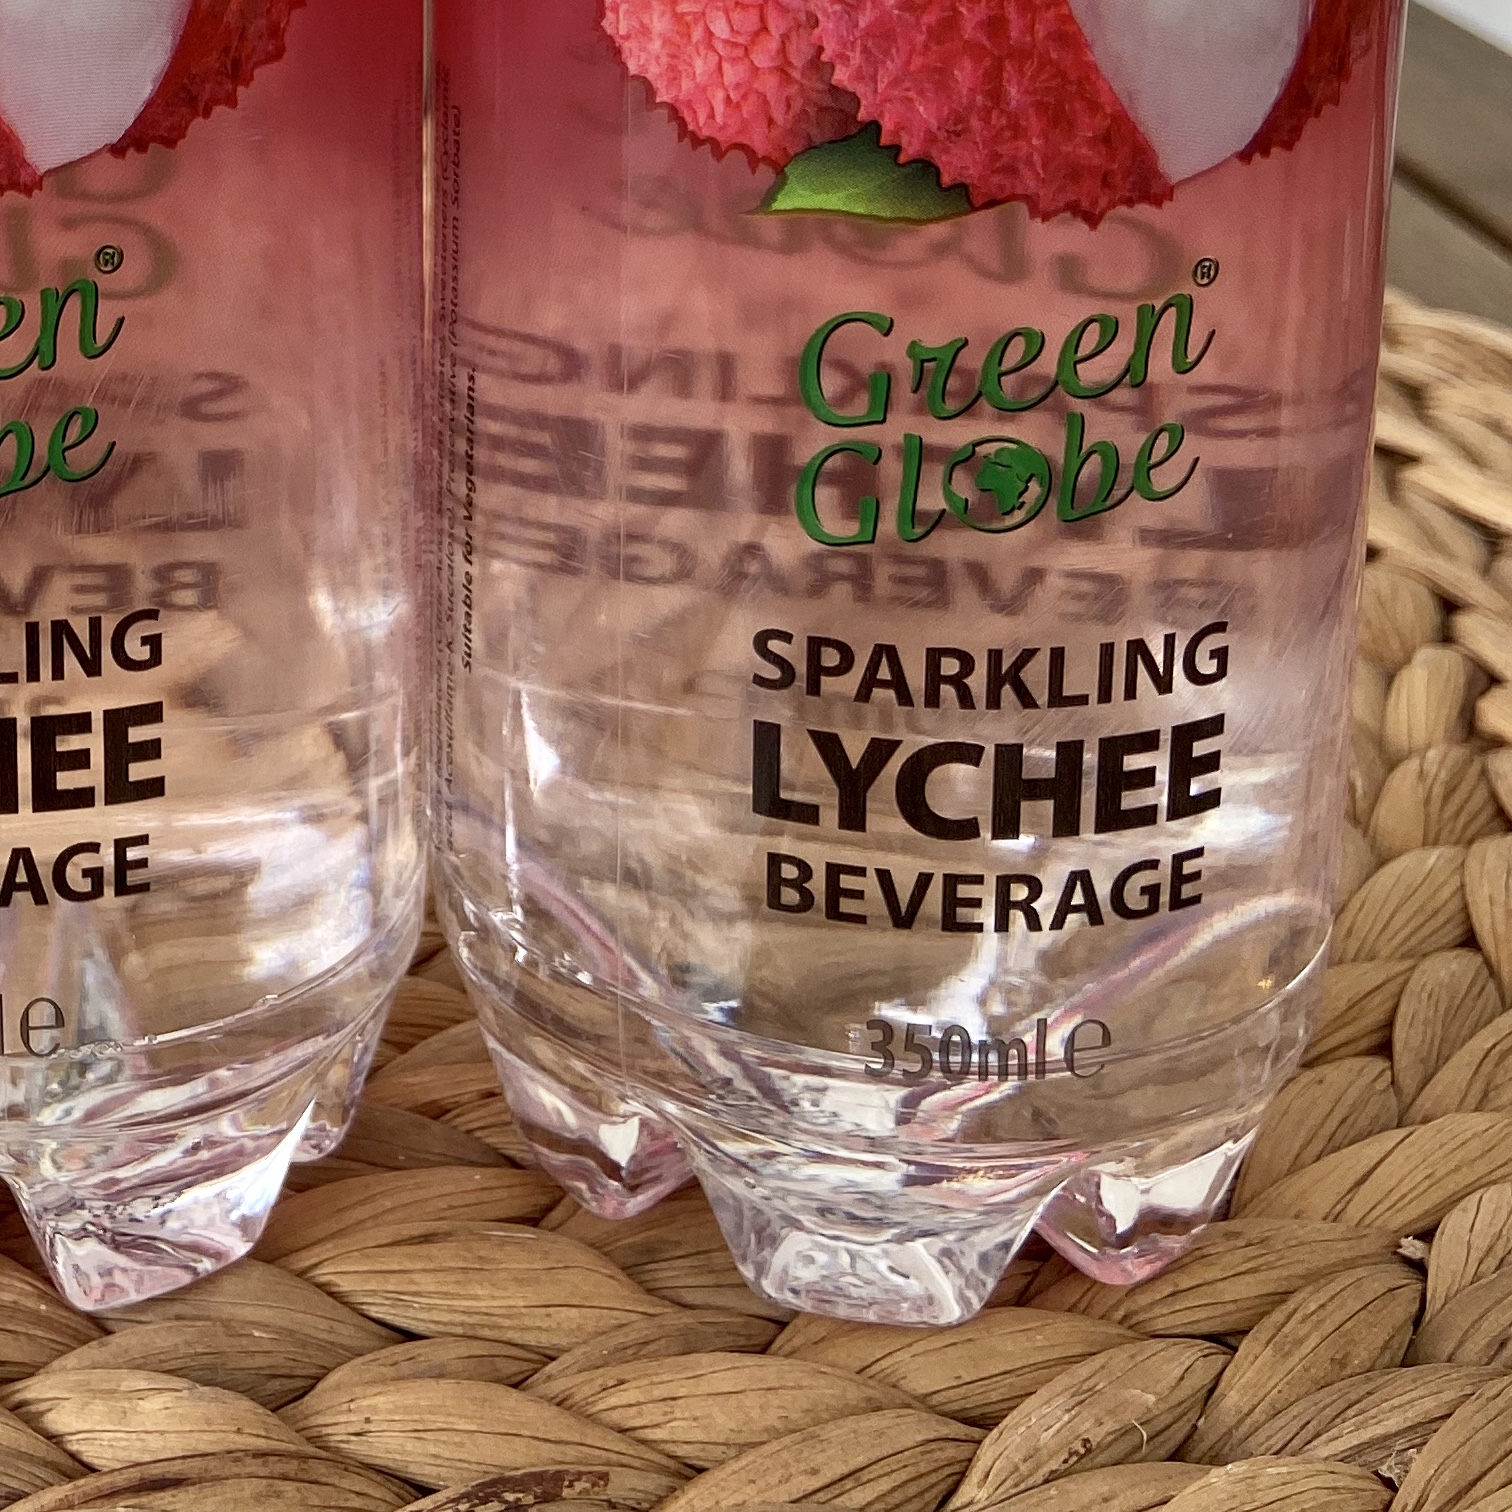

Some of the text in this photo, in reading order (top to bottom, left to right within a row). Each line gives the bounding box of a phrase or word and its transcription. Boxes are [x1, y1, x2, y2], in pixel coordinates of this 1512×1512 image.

[439, 64, 451, 181] (Cyclamic
[449, 104, 462, 210] Sorbate)
[438, 189, 448, 328] Sweeteners
[447, 215, 460, 348] (Potassium
[445, 352, 457, 497] Preservative
[797, 290, 1217, 428] Green
[461, 366, 476, 675] Suitable for Vegetarians.
[793, 411, 1201, 548] Globe
[751, 620, 1231, 712] SPARKLING
[749, 712, 1227, 844] LYCHEE
[764, 845, 1206, 934] BEVERAGE
[862, 1017, 1047, 1084] 350ml
